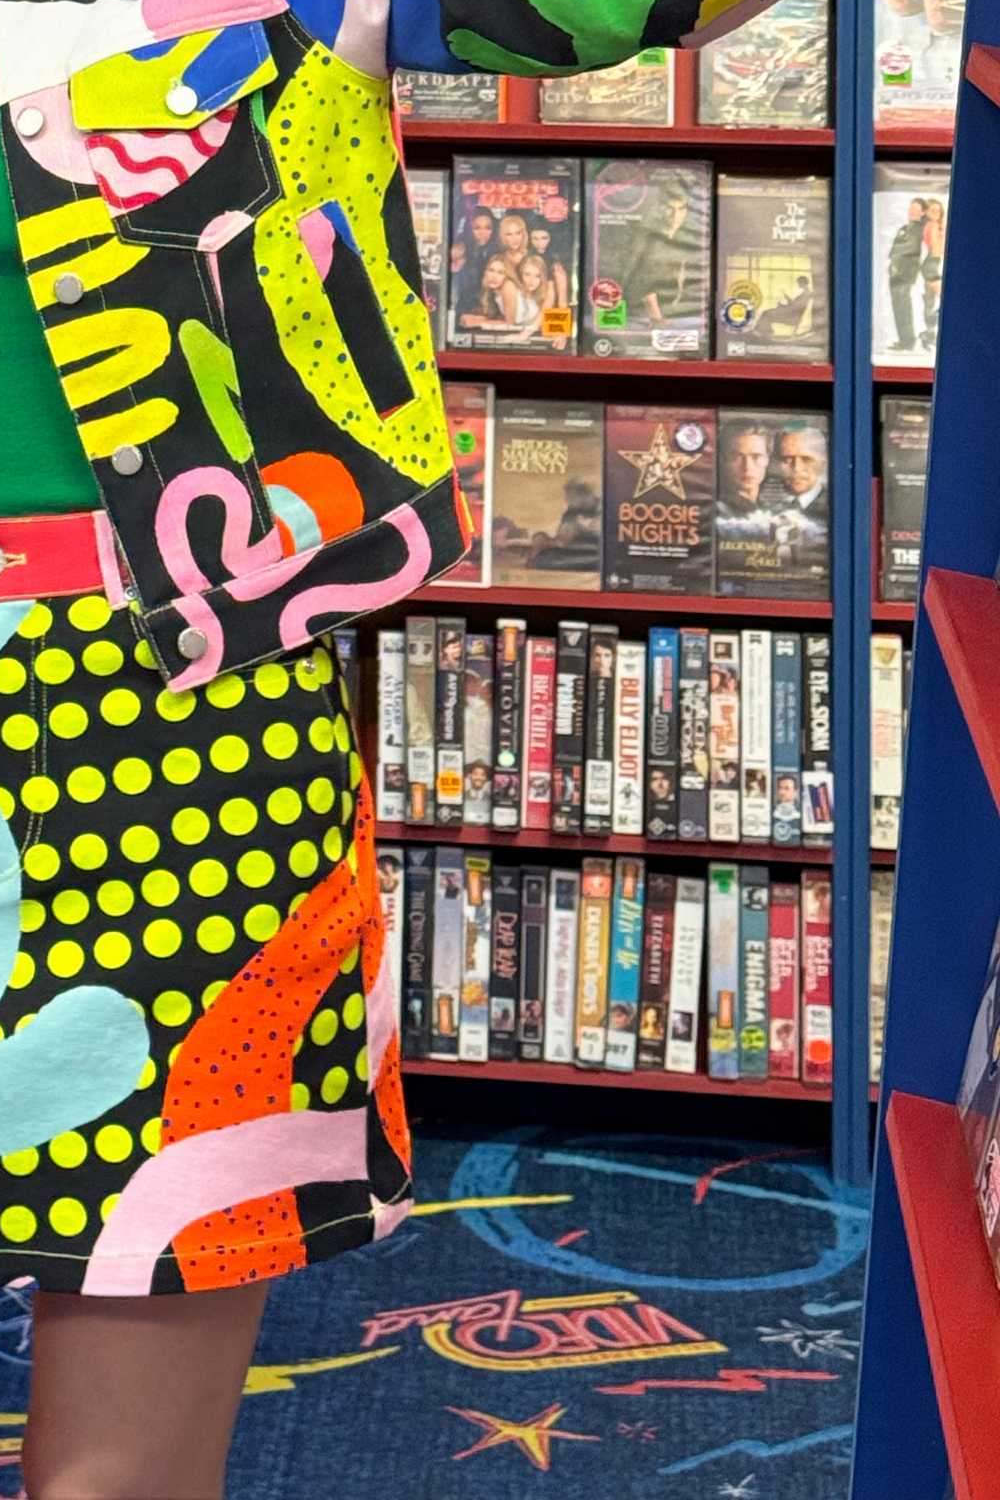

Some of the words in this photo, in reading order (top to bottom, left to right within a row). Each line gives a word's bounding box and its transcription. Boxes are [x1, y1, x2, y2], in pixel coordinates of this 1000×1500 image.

[784, 202, 807, 216] The
[618, 502, 701, 525] BOOGIE
[618, 522, 701, 546] NIGHTS
[891, 548, 921, 565] THE
[500, 660, 512, 752] ELOVED
[532, 673, 549, 701] BIG
[621, 677, 640, 720] BILLY
[530, 703, 550, 753] CHILL
[618, 725, 639, 781] ELLIOT
[648, 913, 664, 985] ELIZABETH
[744, 939, 767, 1024] ENIGMA
[359, 1288, 522, 1347] Land
[454, 1303, 706, 1359] VIDEO
